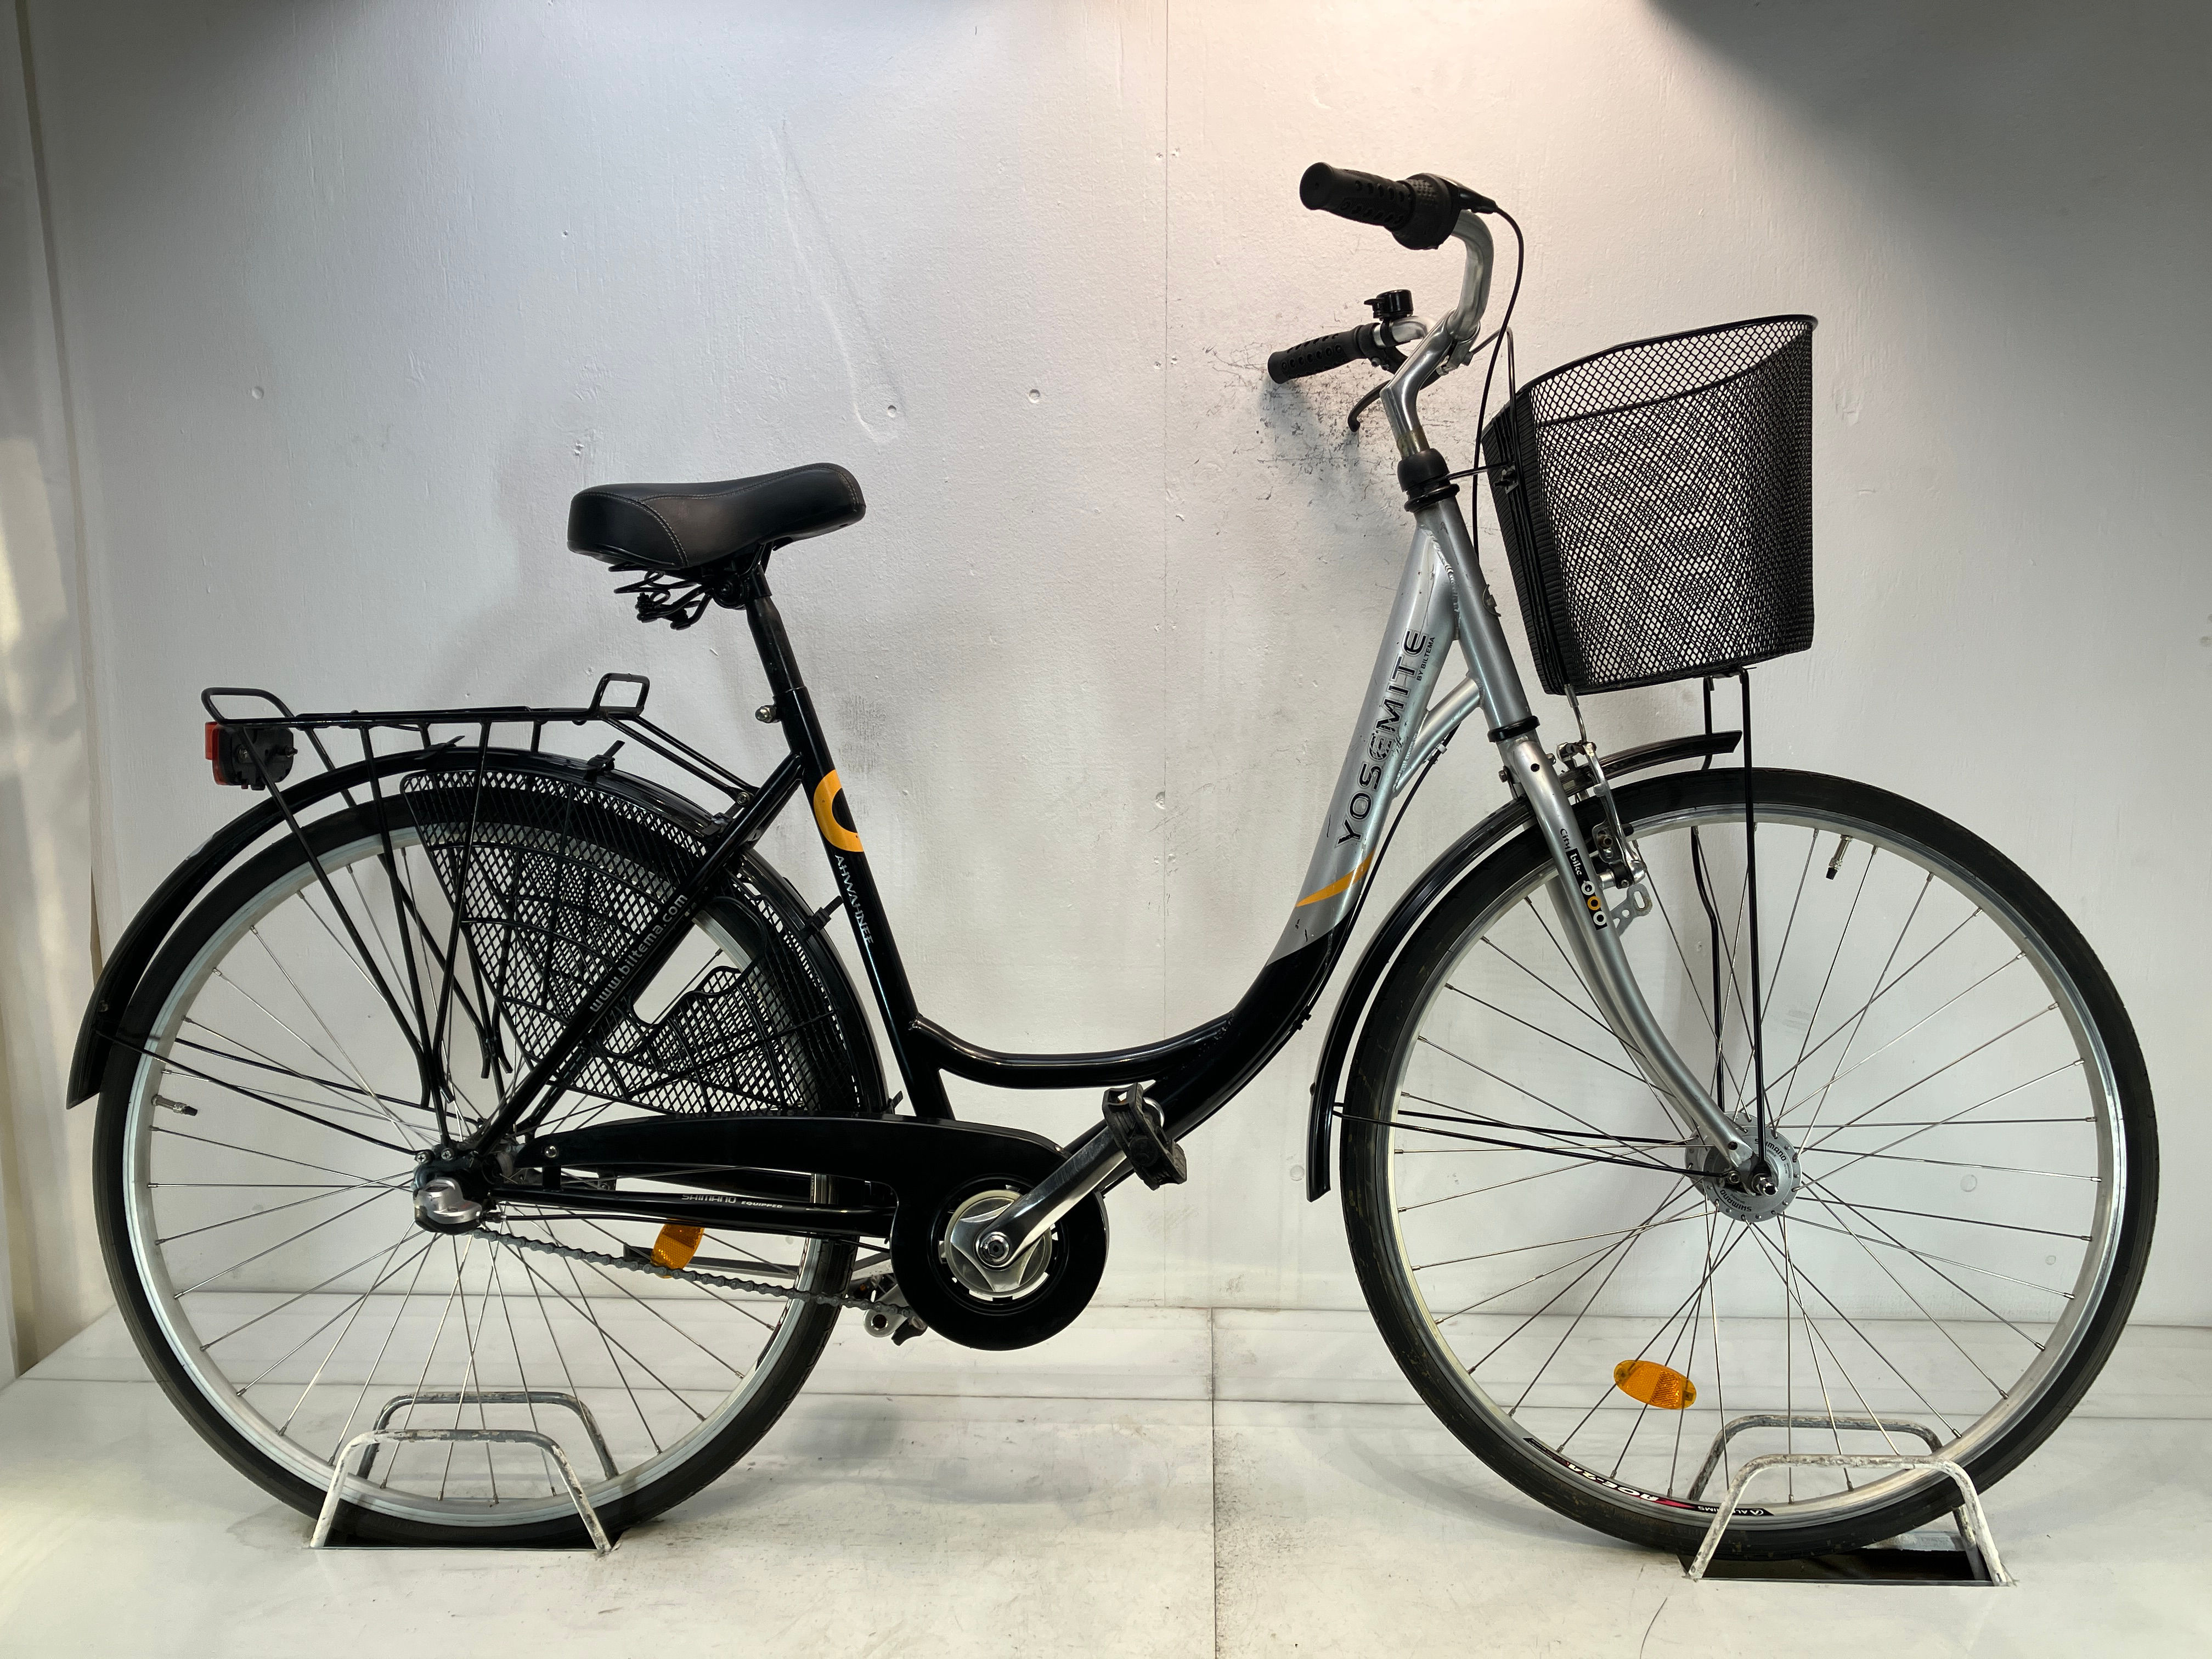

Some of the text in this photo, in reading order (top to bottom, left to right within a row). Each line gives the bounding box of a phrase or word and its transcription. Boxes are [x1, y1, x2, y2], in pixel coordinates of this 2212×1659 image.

[1417, 637, 1435, 681] BY BILTEMA
[1337, 630, 1427, 845] YOSEMITE
[1560, 828, 1582, 876] City bike
[834, 855, 874, 944] AHWAHNEE
[590, 894, 688, 1012] www.biltema.com
[1754, 1138, 1786, 1161] SIMANO
[681, 1194, 783, 1209] SHIMANO EQUIPPED
[1720, 1189, 1752, 1212] SHIMANO
